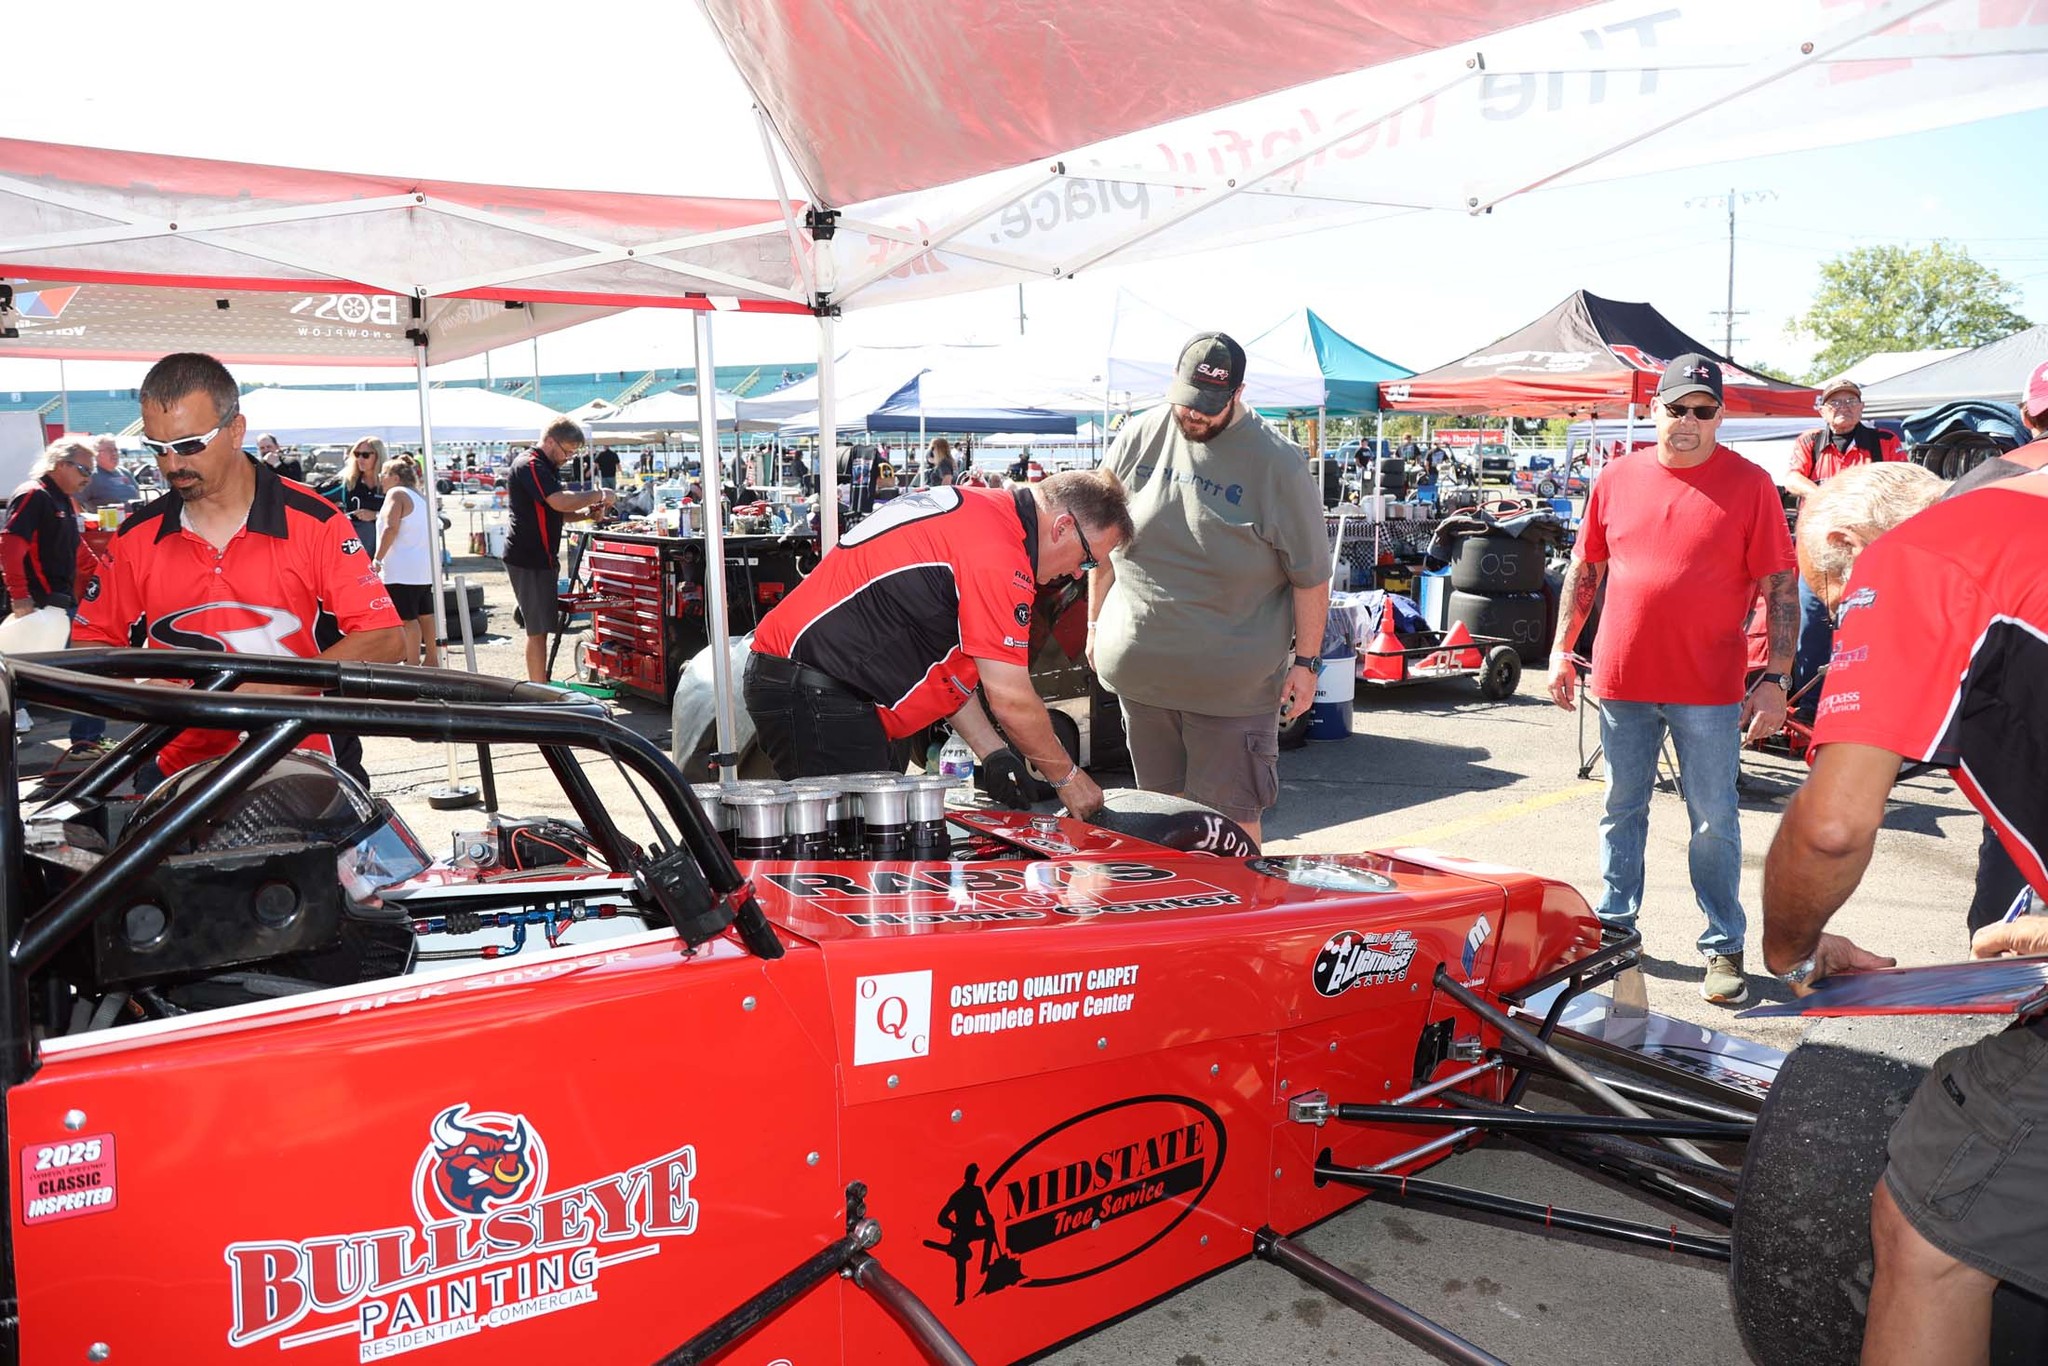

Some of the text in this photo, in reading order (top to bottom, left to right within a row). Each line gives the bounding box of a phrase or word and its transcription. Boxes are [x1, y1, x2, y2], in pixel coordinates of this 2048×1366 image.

[844, 894, 1243, 927] Home Center
[339, 950, 636, 1015] NICK SNYDER
[950, 965, 1139, 1008] OSWEGO QUALITY CARPET
[1341, 945, 1413, 985] LIGHTHOUSE
[1353, 969, 1407, 987] LANES
[861, 979, 878, 999] O
[876, 996, 908, 1039] Q
[951, 993, 1134, 1036] Complete Floor Center
[911, 1034, 926, 1053] C
[34, 1139, 103, 1171] 2025
[1004, 1120, 1206, 1221] MIDSTATE
[27, 1186, 113, 1218] INSPECTED
[39, 1171, 101, 1195] CLASSIC
[1054, 1178, 1165, 1236] Tree Service
[228, 1146, 696, 1346] BULLSEYE
[361, 1250, 596, 1336] PAINTING
[361, 1287, 593, 1359] RESIDENTIAL COMMERCIAL
